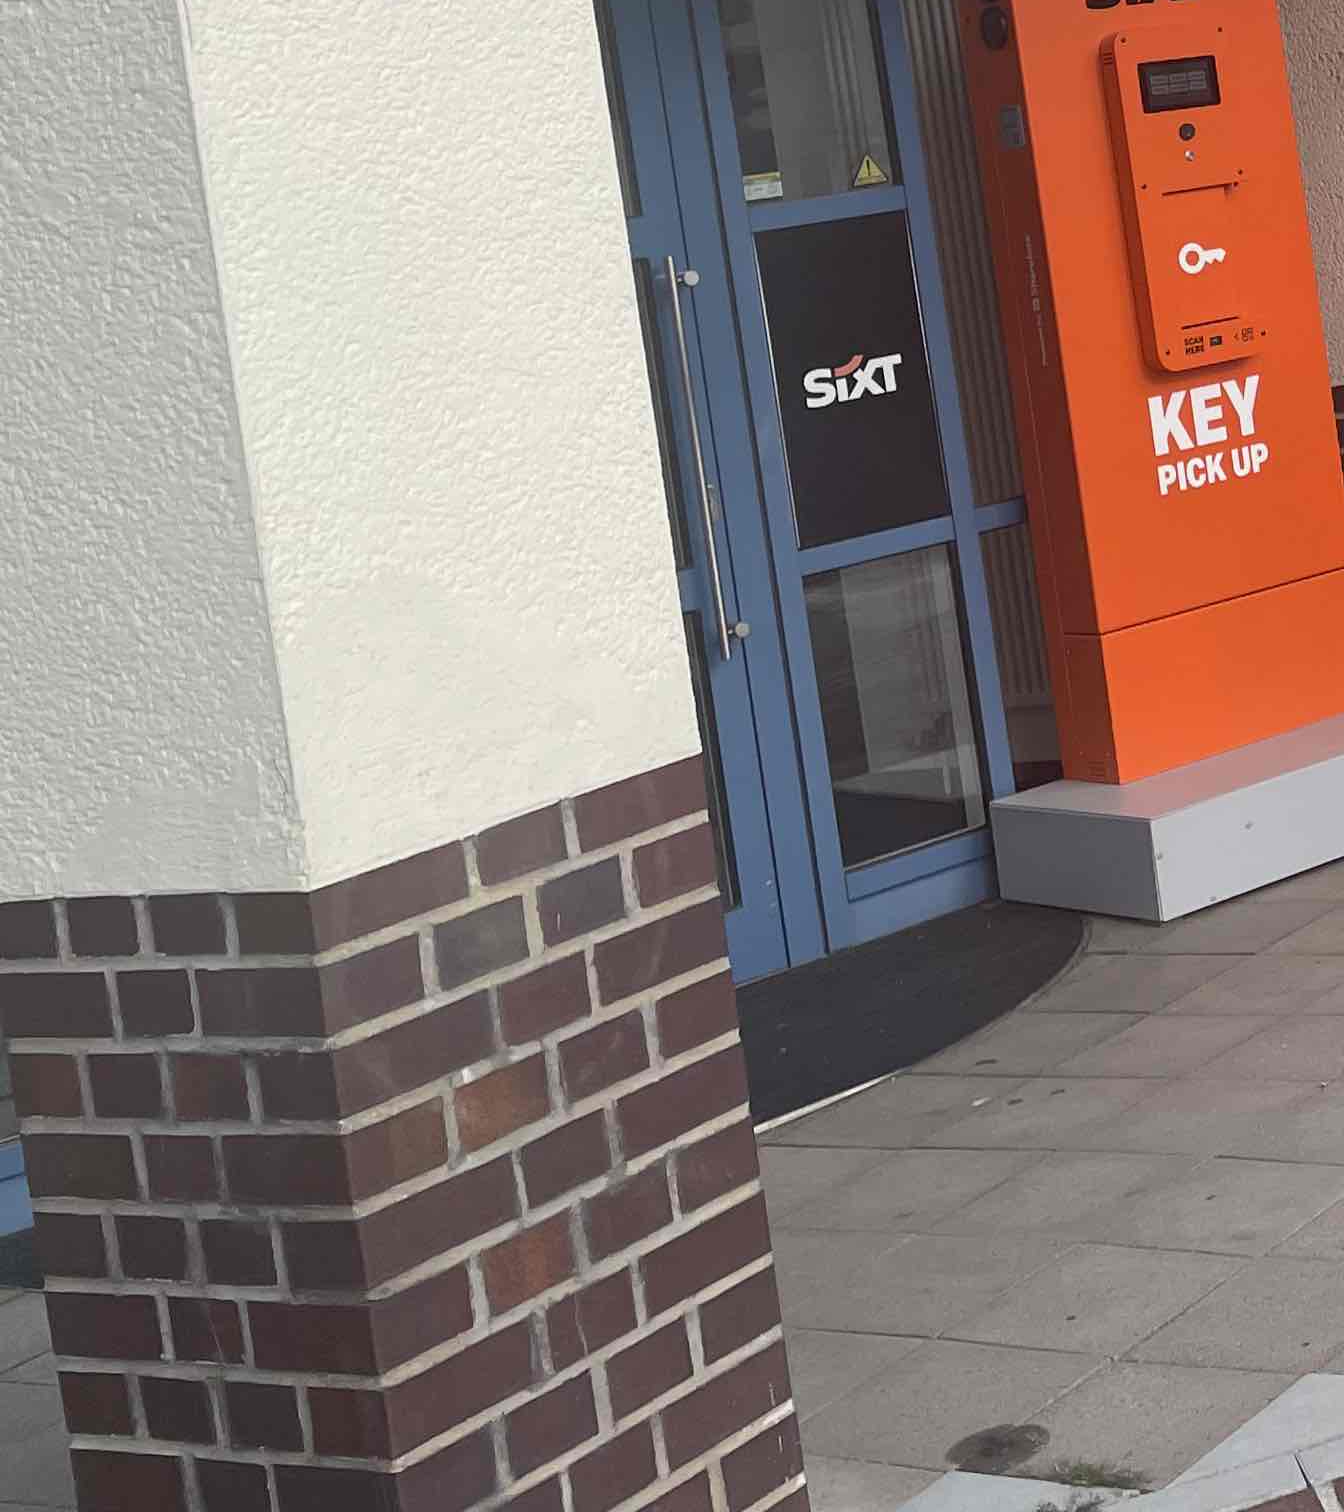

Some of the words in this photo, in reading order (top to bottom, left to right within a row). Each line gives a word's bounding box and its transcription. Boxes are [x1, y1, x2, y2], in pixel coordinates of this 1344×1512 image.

[1147, 374, 1260, 457] KEY
[1157, 451, 1227, 495] PICK
[1231, 442, 1269, 477] UP
